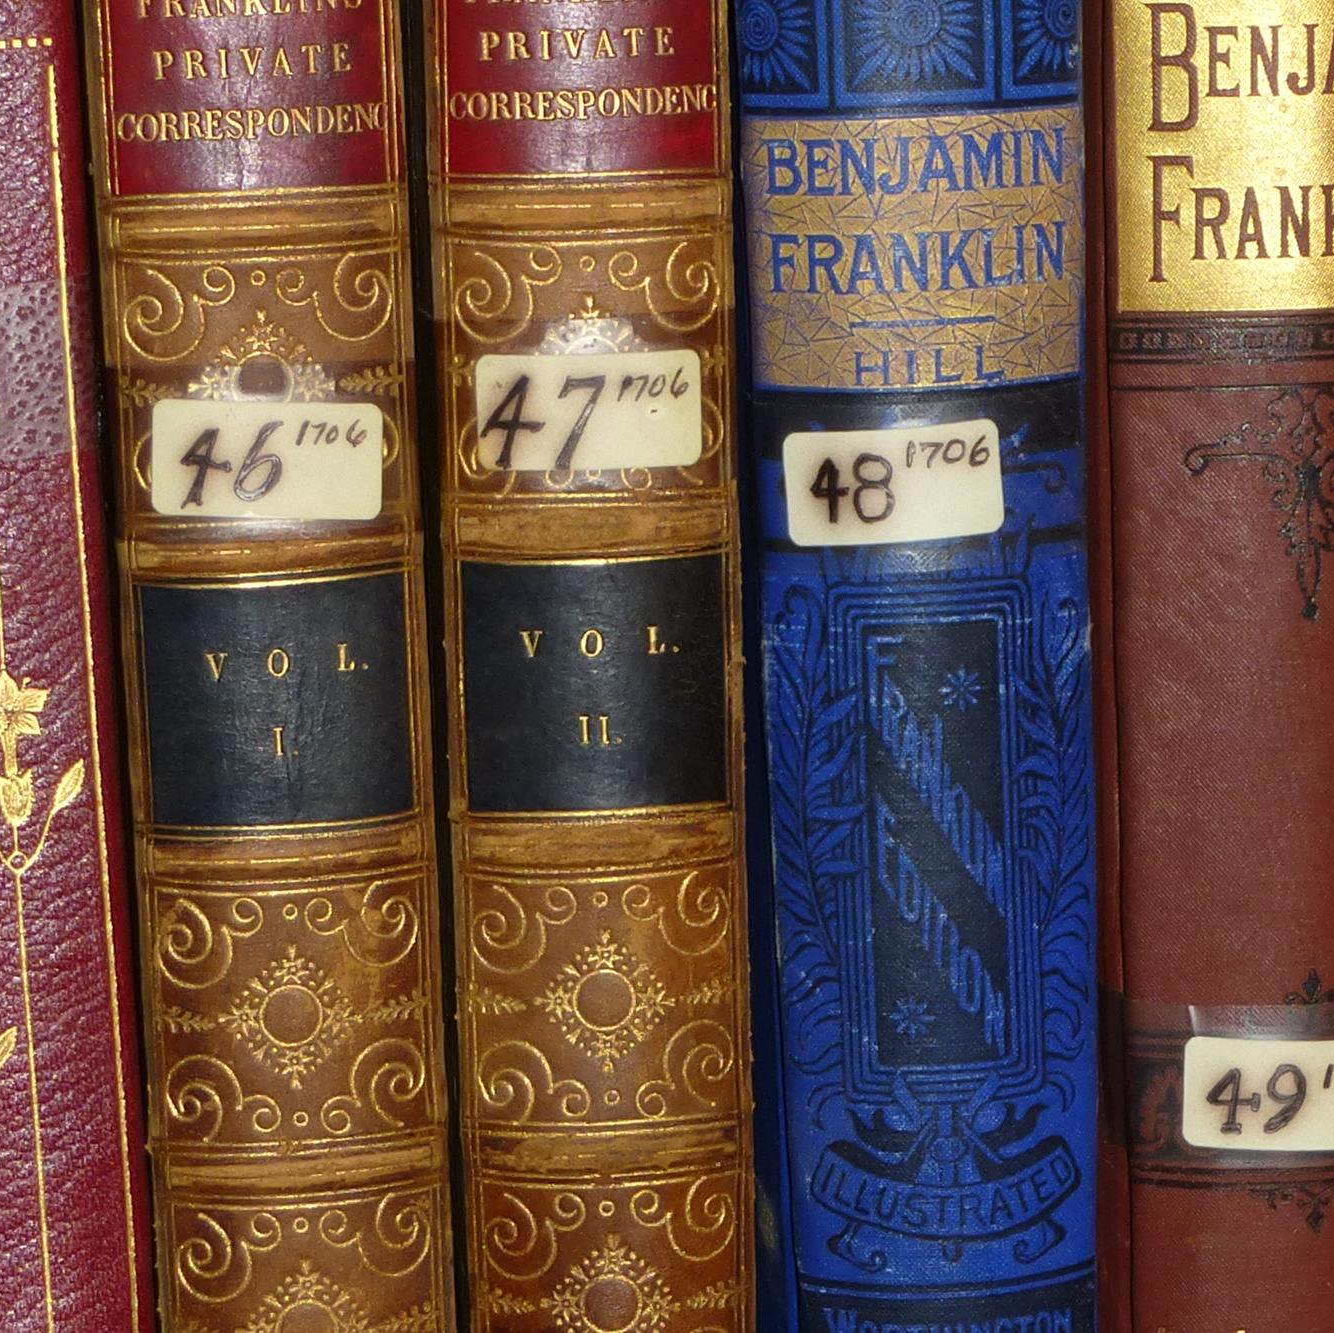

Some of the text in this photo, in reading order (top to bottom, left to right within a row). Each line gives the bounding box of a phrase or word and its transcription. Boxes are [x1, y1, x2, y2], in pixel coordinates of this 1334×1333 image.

[154, 43, 353, 81] PRIVATE
[479, 26, 675, 62] PRIVATE
[117, 102, 388, 143] CORRESPONDENC
[449, 83, 717, 121] CORRESPONDENC
[766, 126, 1065, 198] BENJAMIN
[769, 220, 1066, 295] FRANKLIN
[854, 345, 1005, 388] HILL
[480, 371, 691, 471] 47 1706
[179, 417, 368, 509] 46 1706
[810, 435, 991, 525] 48 1706
[1206, 1063, 1309, 1135] 49
[820, 1155, 1074, 1230] ILLUSTRATED
